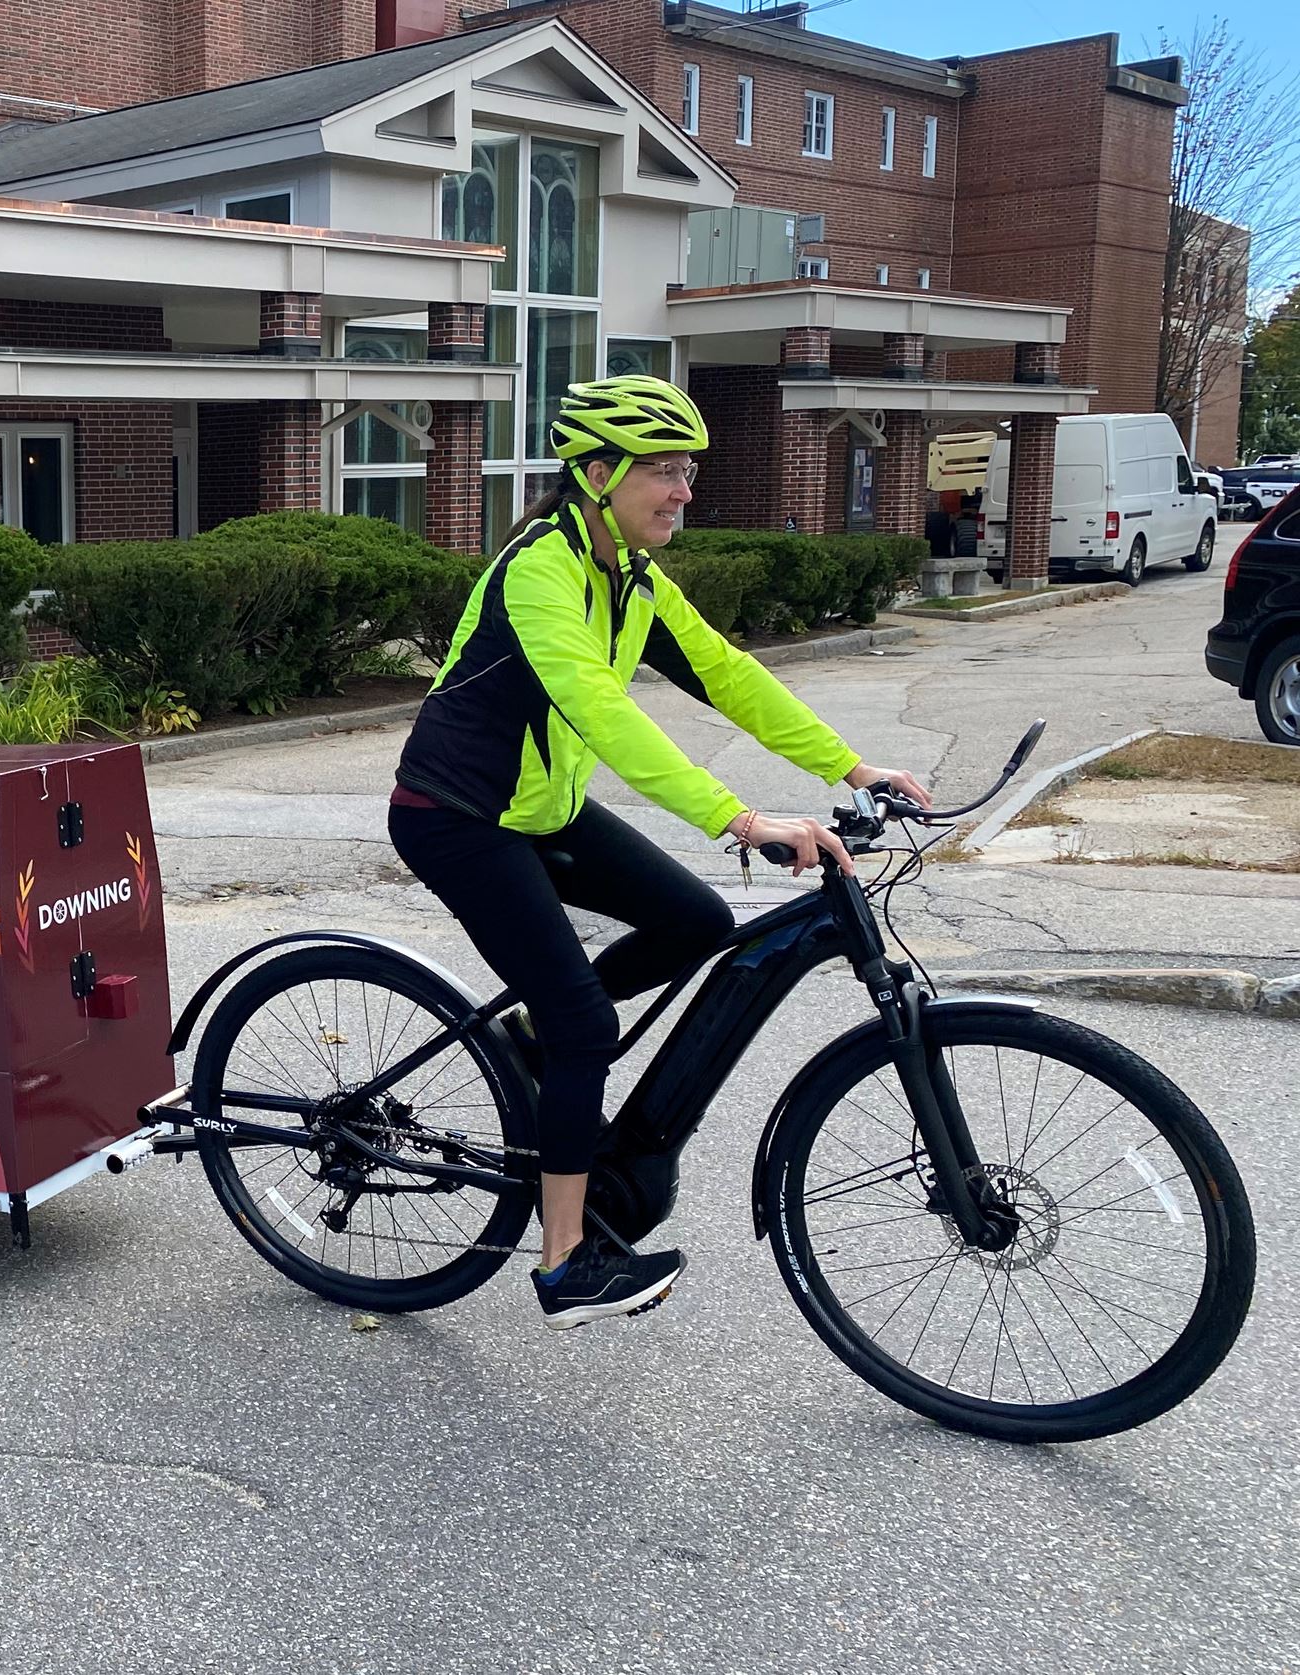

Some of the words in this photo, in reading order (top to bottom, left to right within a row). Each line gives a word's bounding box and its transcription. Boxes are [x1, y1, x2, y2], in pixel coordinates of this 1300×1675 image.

[1261, 489, 1288, 498] PO
[38, 877, 131, 931] DOWNING
[192, 1117, 238, 1134] SURLY
